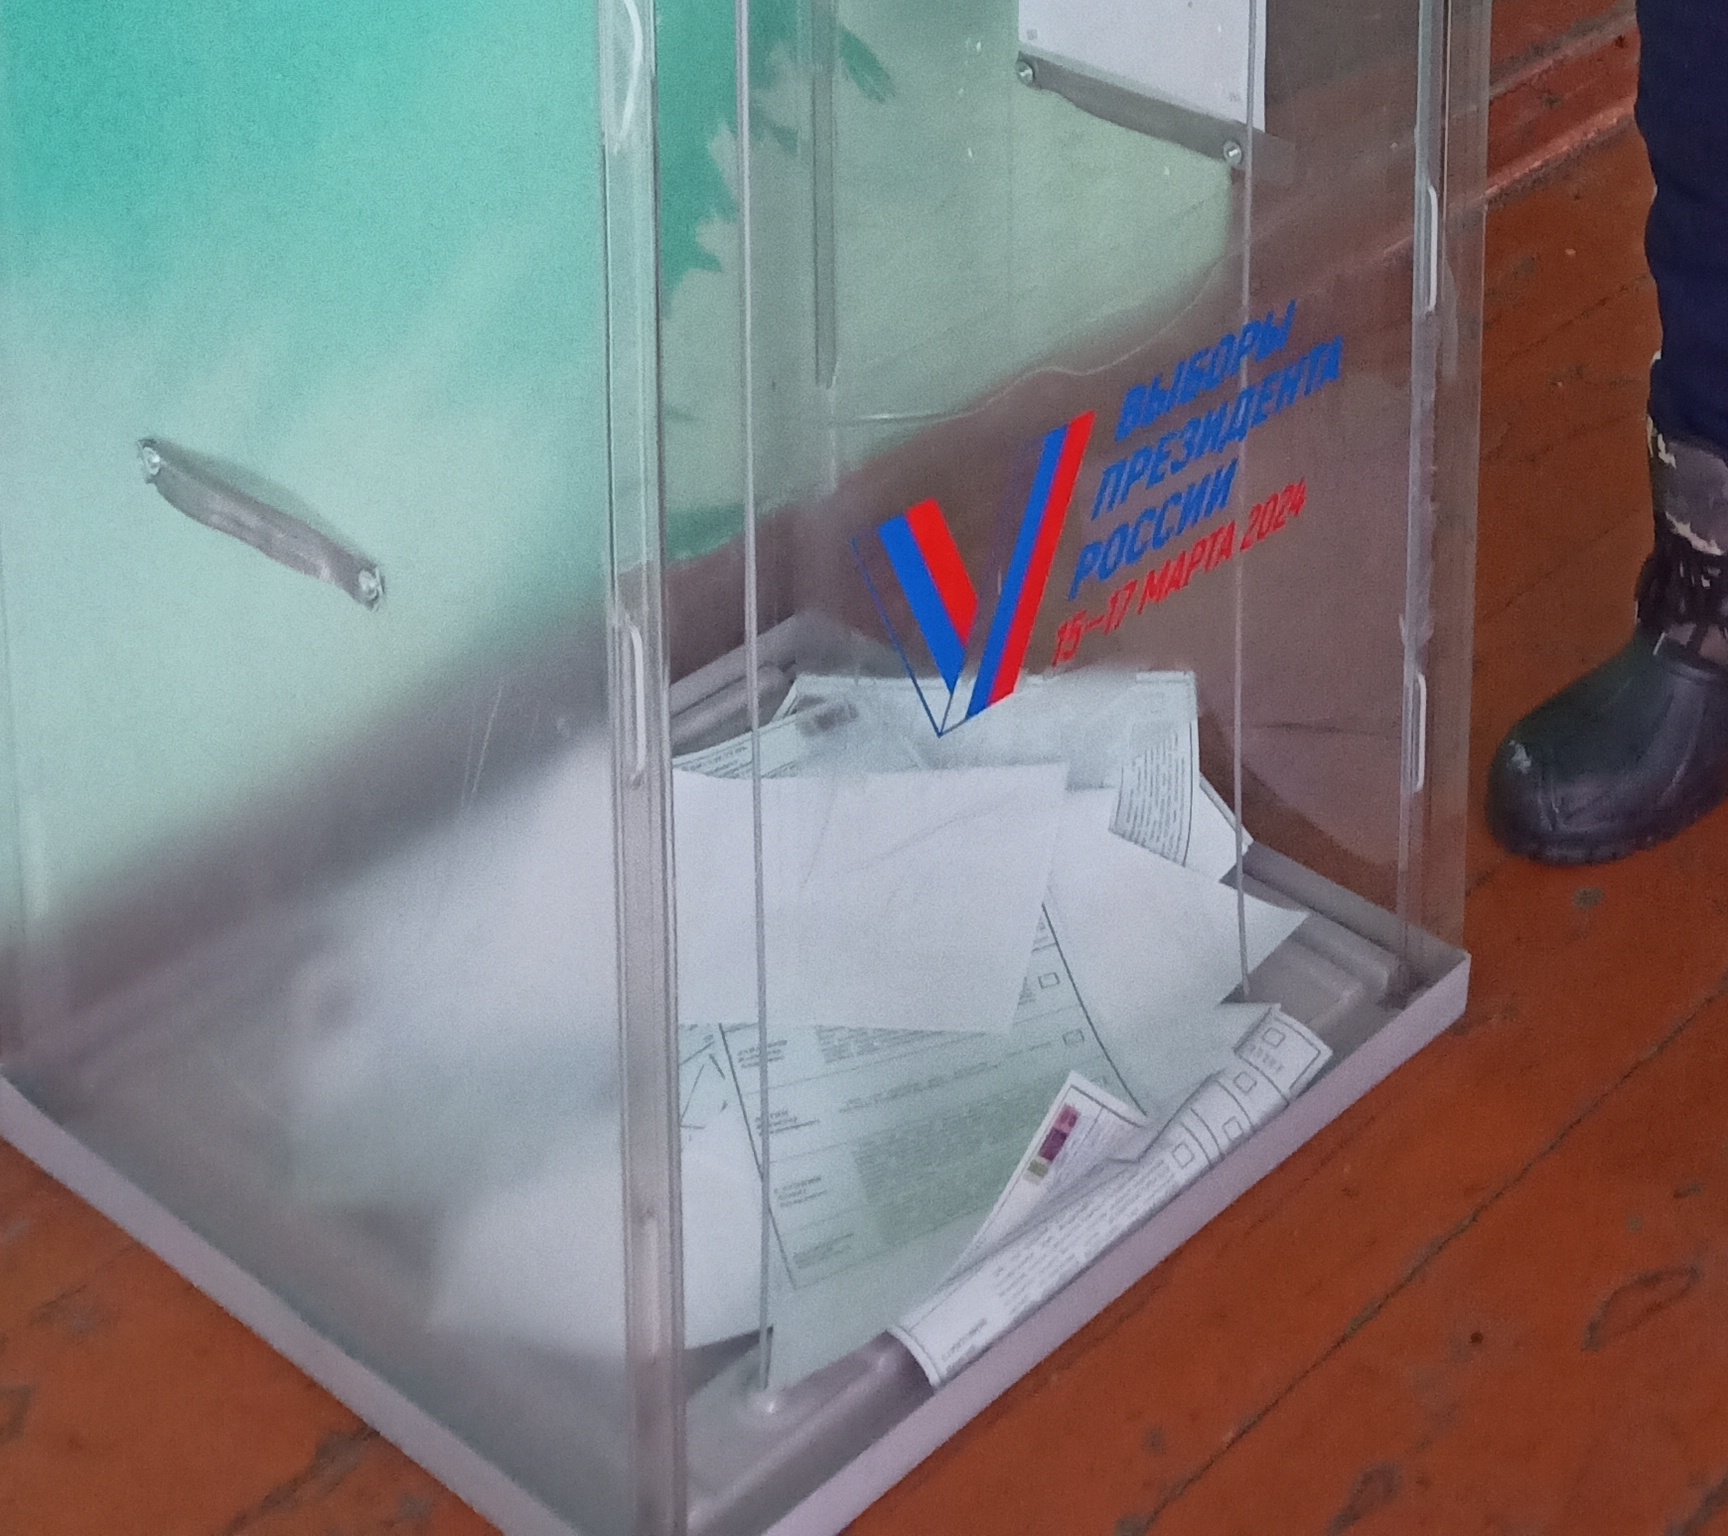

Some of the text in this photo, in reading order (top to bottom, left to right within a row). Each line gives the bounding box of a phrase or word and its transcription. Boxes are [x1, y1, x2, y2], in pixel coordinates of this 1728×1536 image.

[1090, 334, 1343, 522] ПРЕЗИДЕНТА
[1115, 299, 1297, 443] ВЫБОРЫ
[1067, 456, 1239, 603] РОССИИ
[1136, 519, 1236, 616] МАРТА
[1239, 475, 1307, 553] 2024
